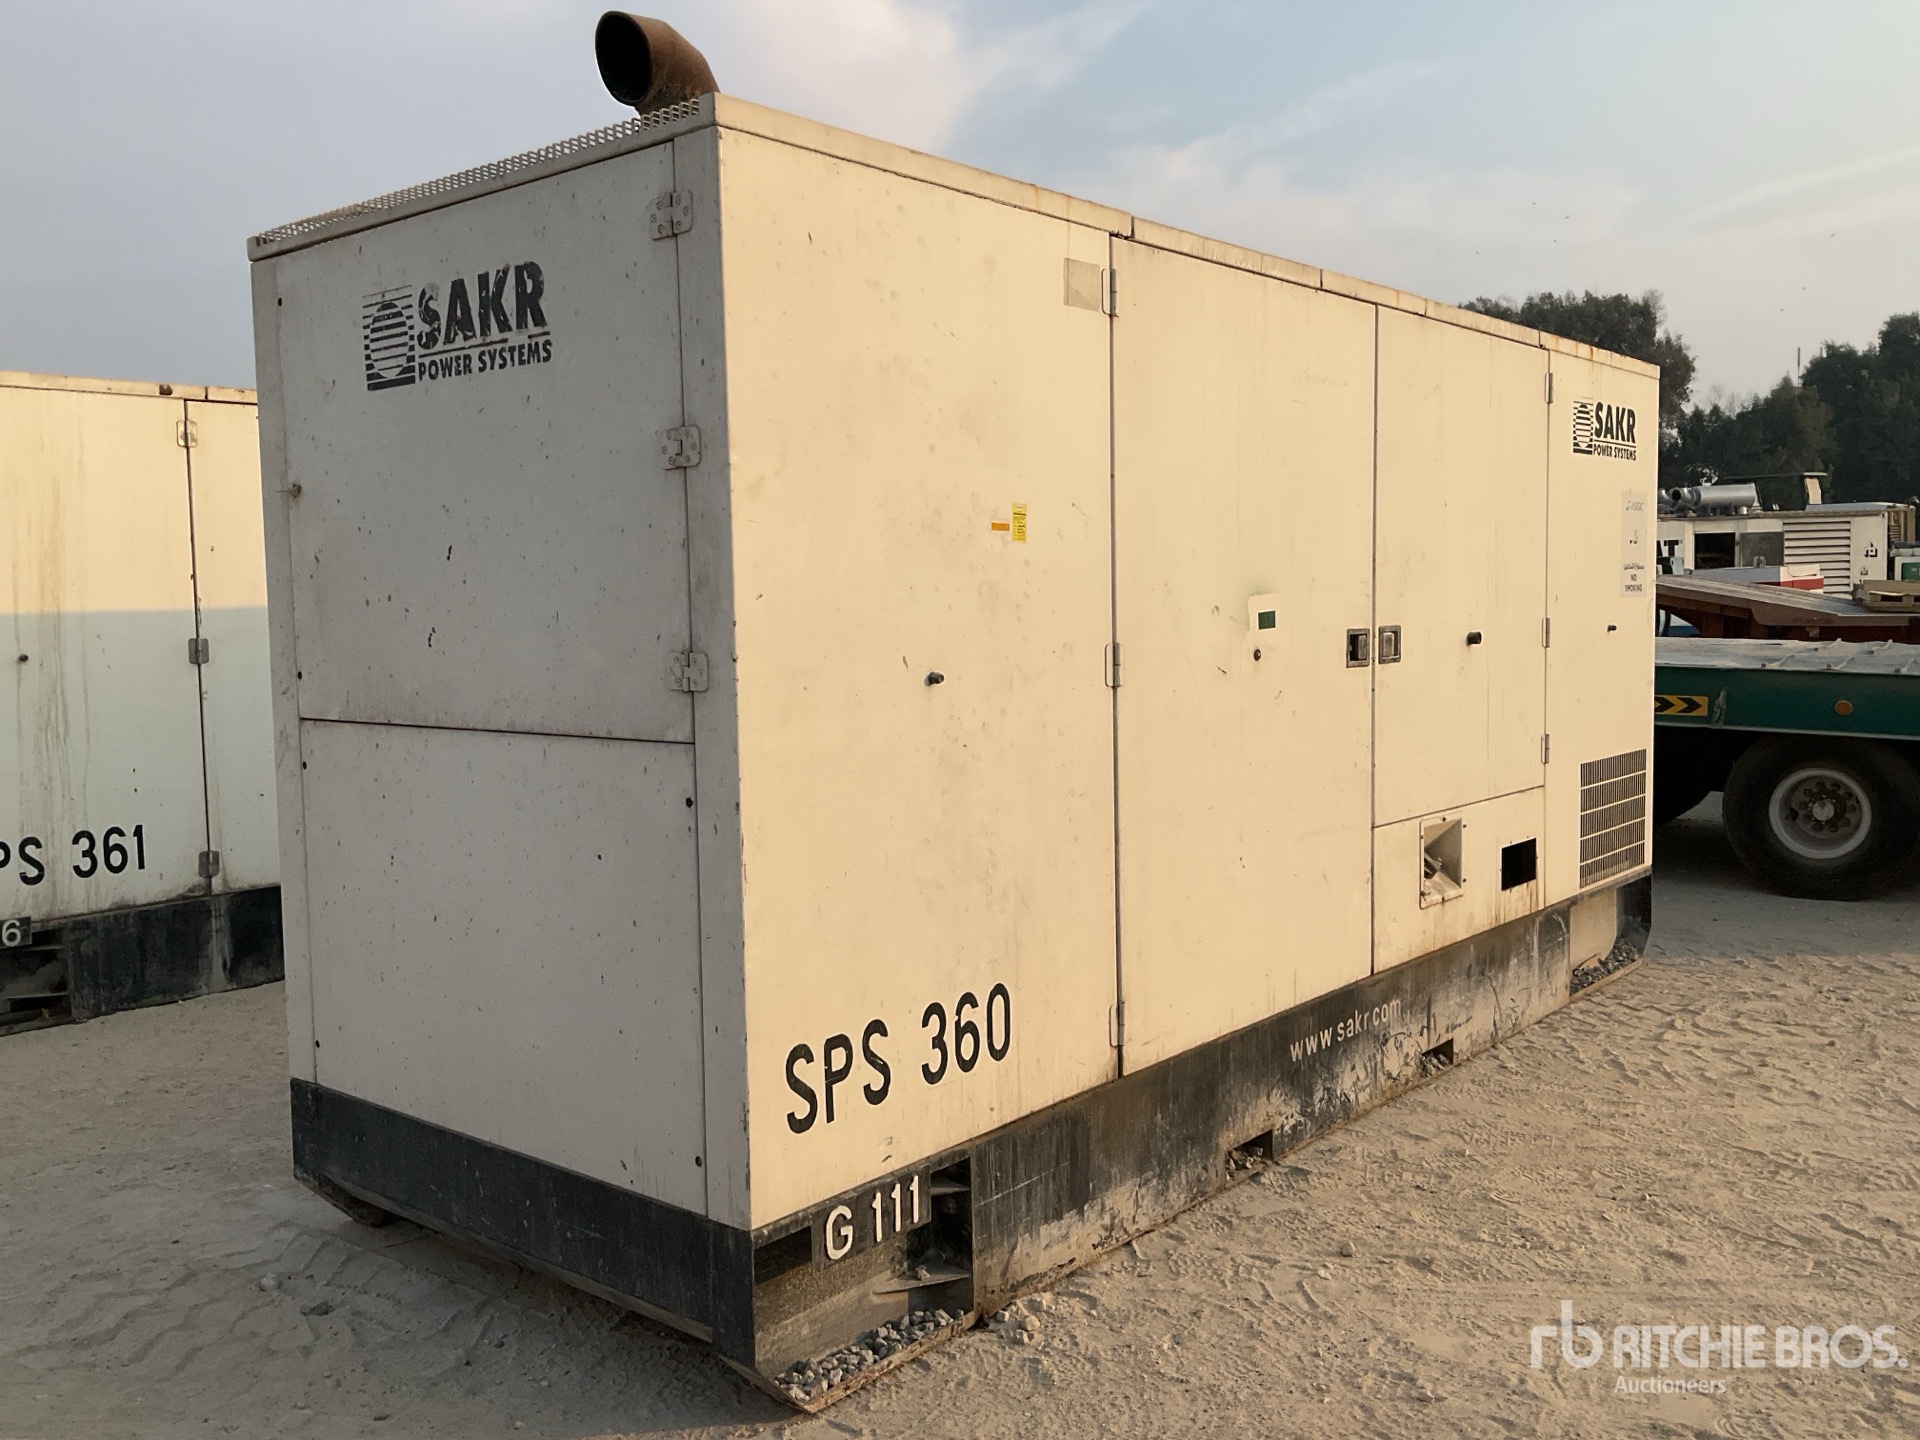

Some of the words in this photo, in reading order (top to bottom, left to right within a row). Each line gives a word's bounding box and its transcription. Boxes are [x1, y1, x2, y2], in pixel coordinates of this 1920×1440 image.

[417, 261, 547, 349] SAKR
[418, 354, 473, 381] POWER
[478, 340, 553, 373] SYSTEMS
[1594, 401, 1636, 444] SAKR
[1593, 443, 1613, 457] POWER
[1613, 446, 1637, 461] SYSTEMS
[72, 824, 146, 878] 361
[785, 1018, 892, 1134] SPS
[921, 982, 1011, 1085] 360
[825, 1205, 854, 1260] G
[871, 1175, 919, 1243] 111
